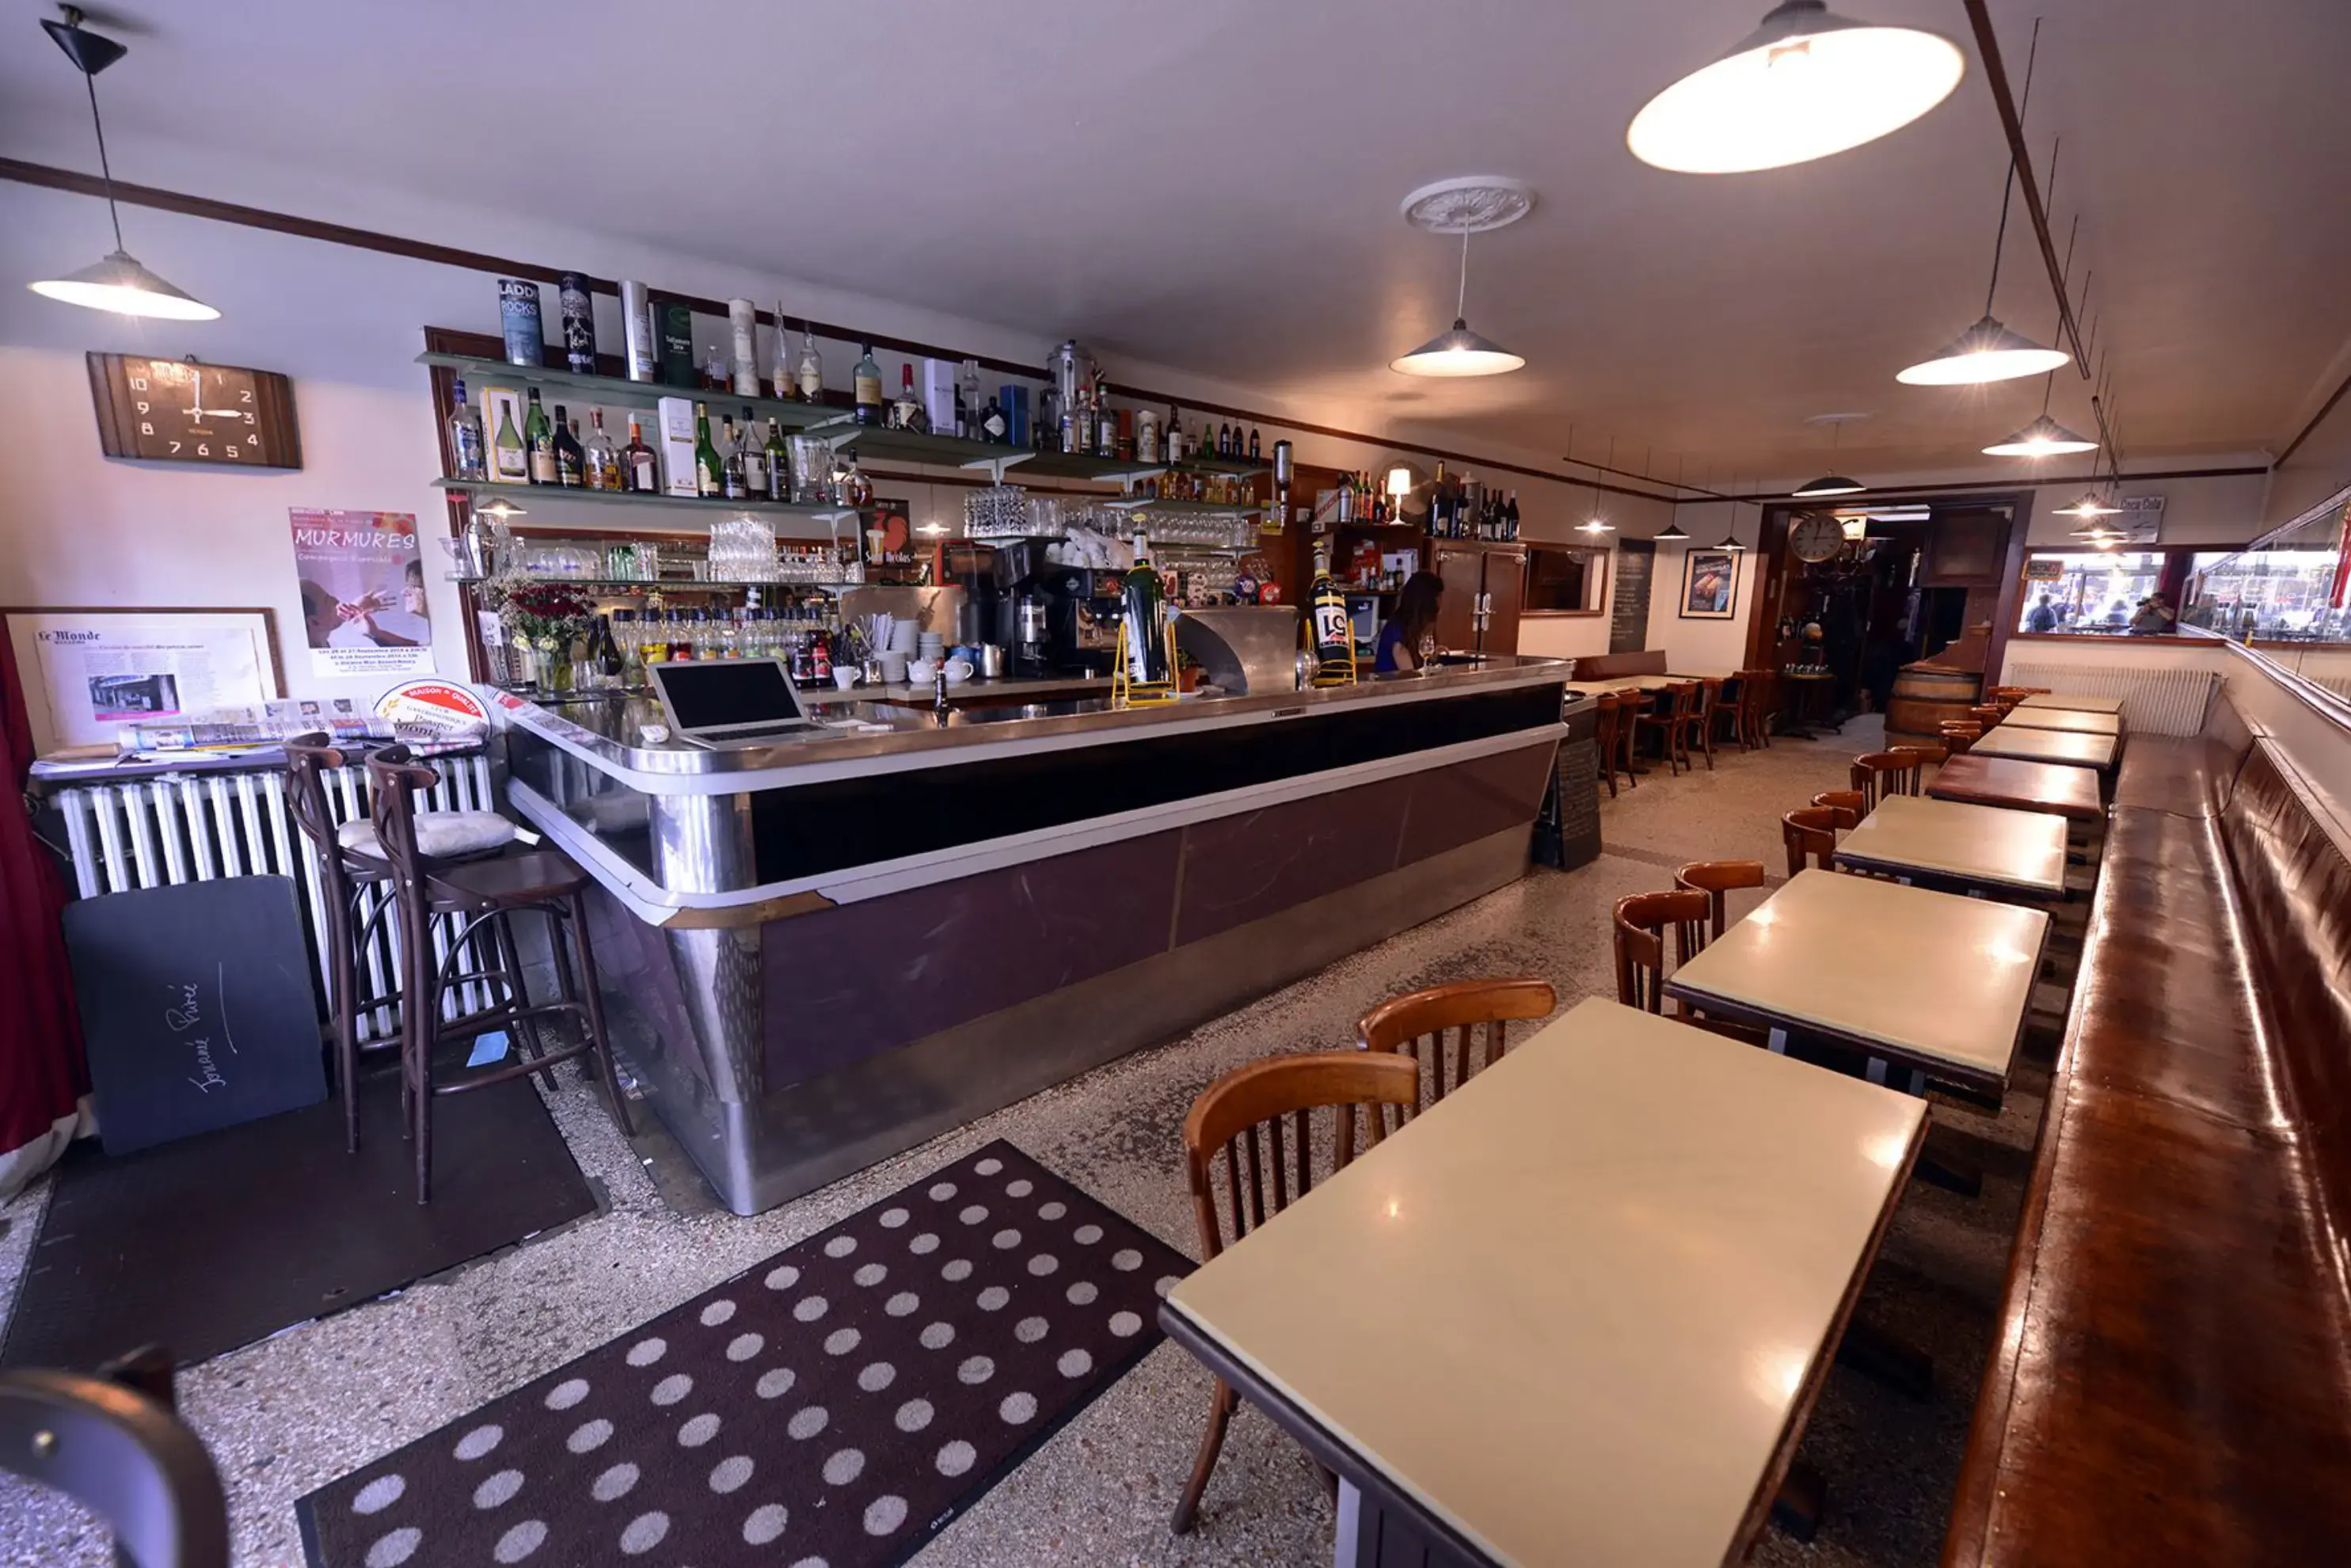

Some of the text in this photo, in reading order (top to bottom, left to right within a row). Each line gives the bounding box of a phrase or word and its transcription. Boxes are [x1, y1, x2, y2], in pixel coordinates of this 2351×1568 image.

[500, 301, 538, 316] ROCKS
[130, 377, 147, 391] 10
[240, 390, 253, 402] 2
[137, 402, 150, 414] 9
[243, 412, 255, 425] 3
[141, 422, 154, 436] 8
[247, 434, 259, 447] 4
[169, 441, 181, 454] 7
[197, 443, 209, 456] 6
[226, 445, 238, 458] 5
[295, 528, 415, 550] MURMURES
[1323, 615, 1346, 637] 51
[38, 630, 101, 641] Le Monde
[409, 687, 442, 696] MAISON
